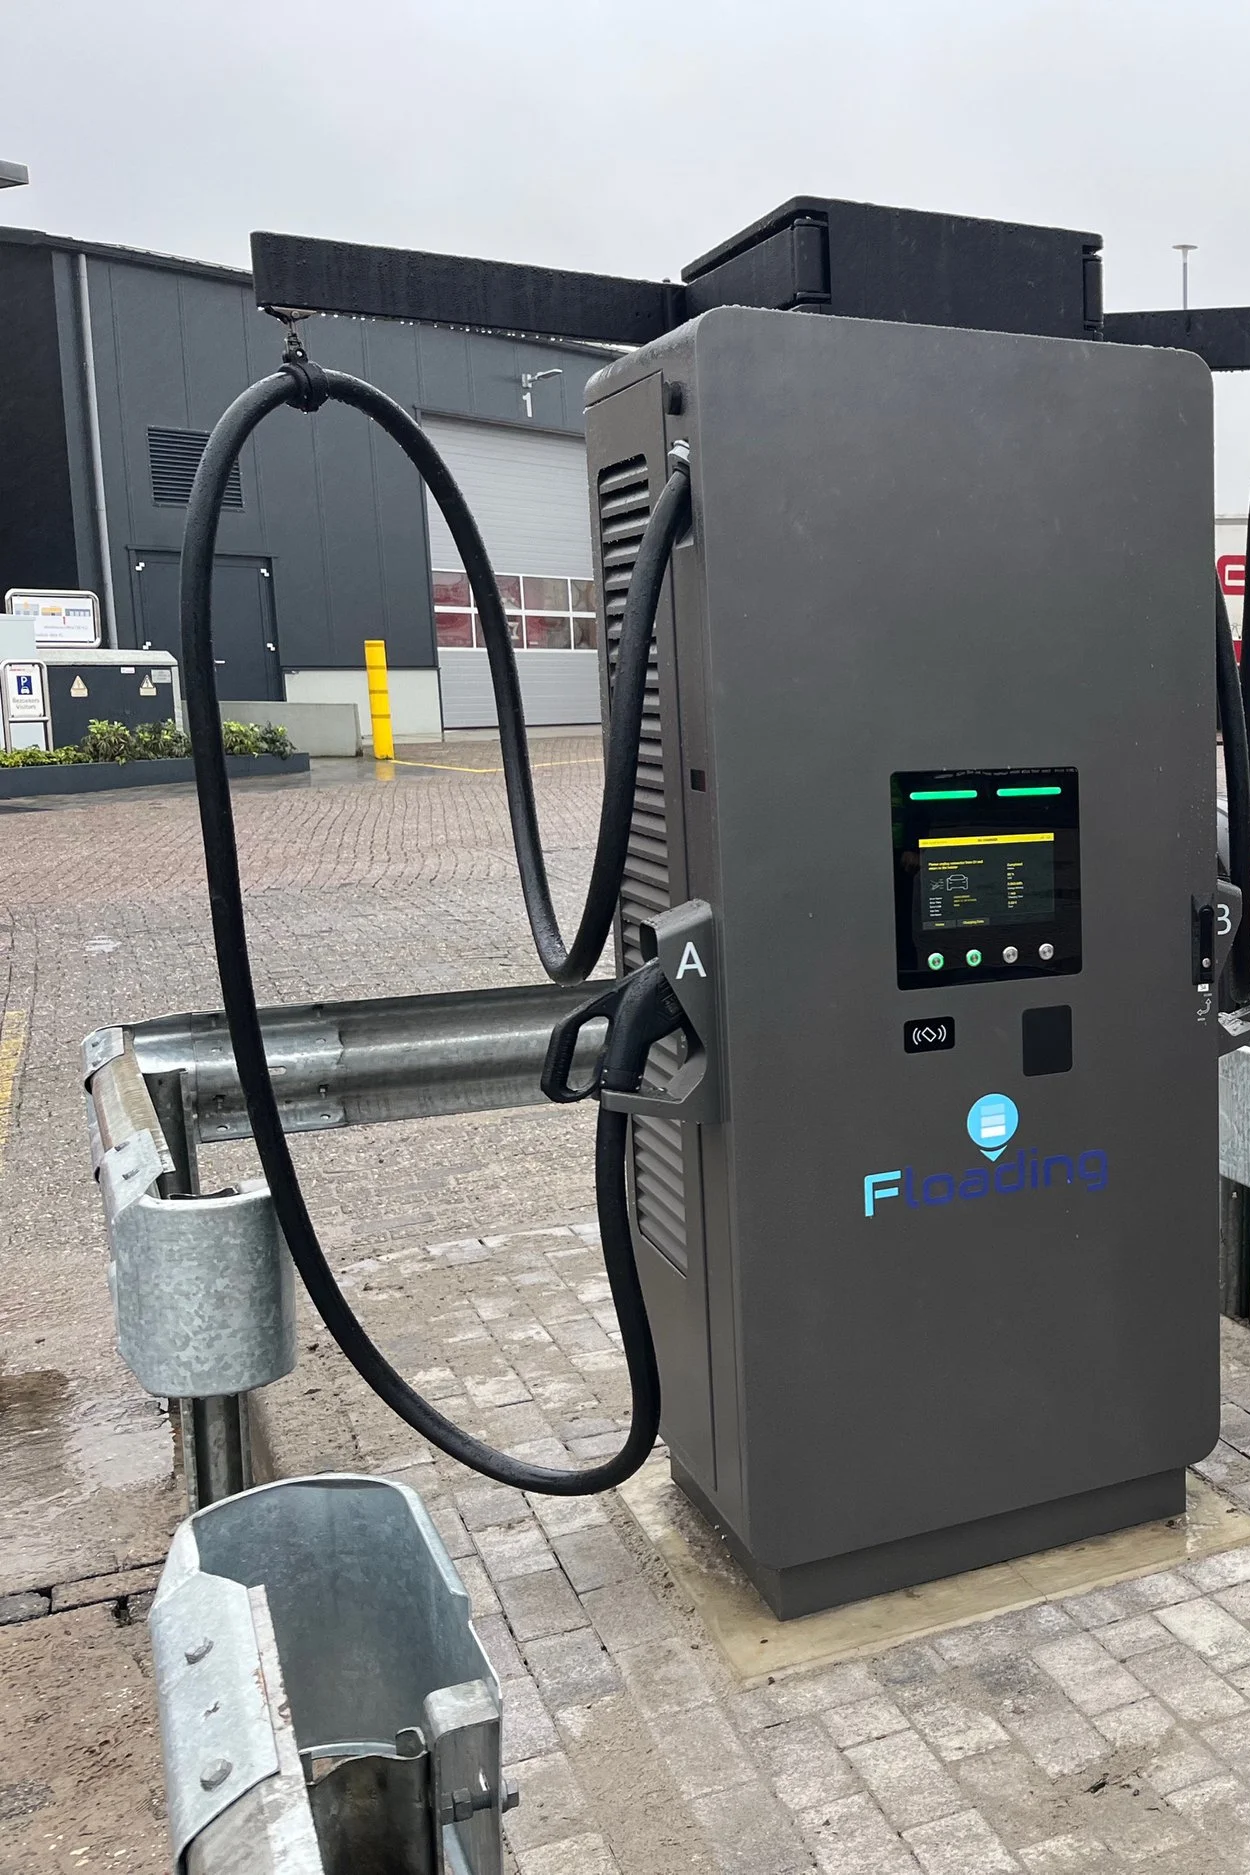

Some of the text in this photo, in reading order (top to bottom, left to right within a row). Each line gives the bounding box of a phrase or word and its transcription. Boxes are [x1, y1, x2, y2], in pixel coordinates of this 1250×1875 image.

[522, 392, 532, 418] 1
[675, 941, 707, 979] A
[864, 1148, 1108, 1217] Floading
